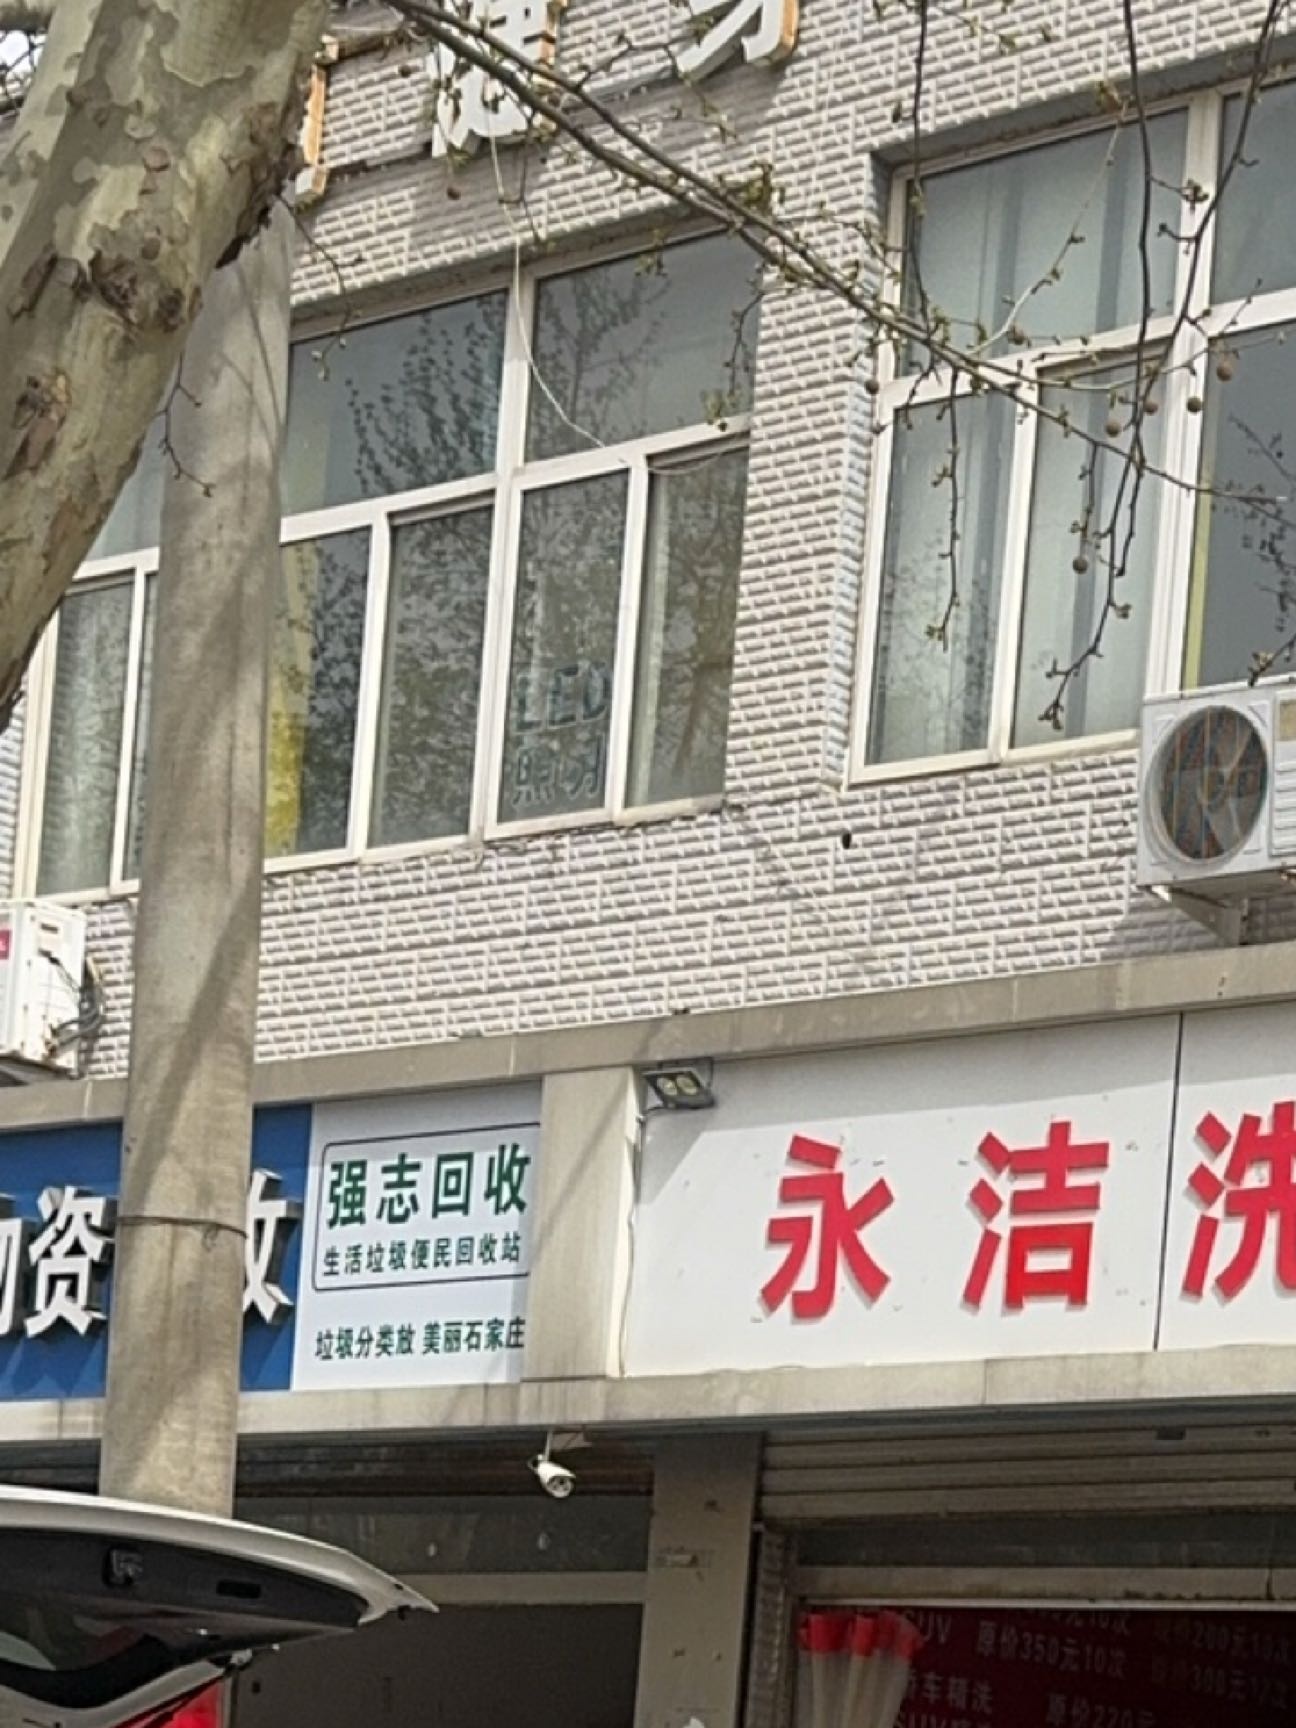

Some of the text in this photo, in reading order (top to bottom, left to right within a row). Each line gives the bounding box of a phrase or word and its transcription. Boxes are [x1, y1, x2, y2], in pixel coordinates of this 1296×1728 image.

[327, 1143, 531, 1230] 强志回收
[323, 1231, 521, 1276] 生活垃圾便民回收站
[315, 1316, 526, 1360] 垃圾分类放 美丽石家庄
